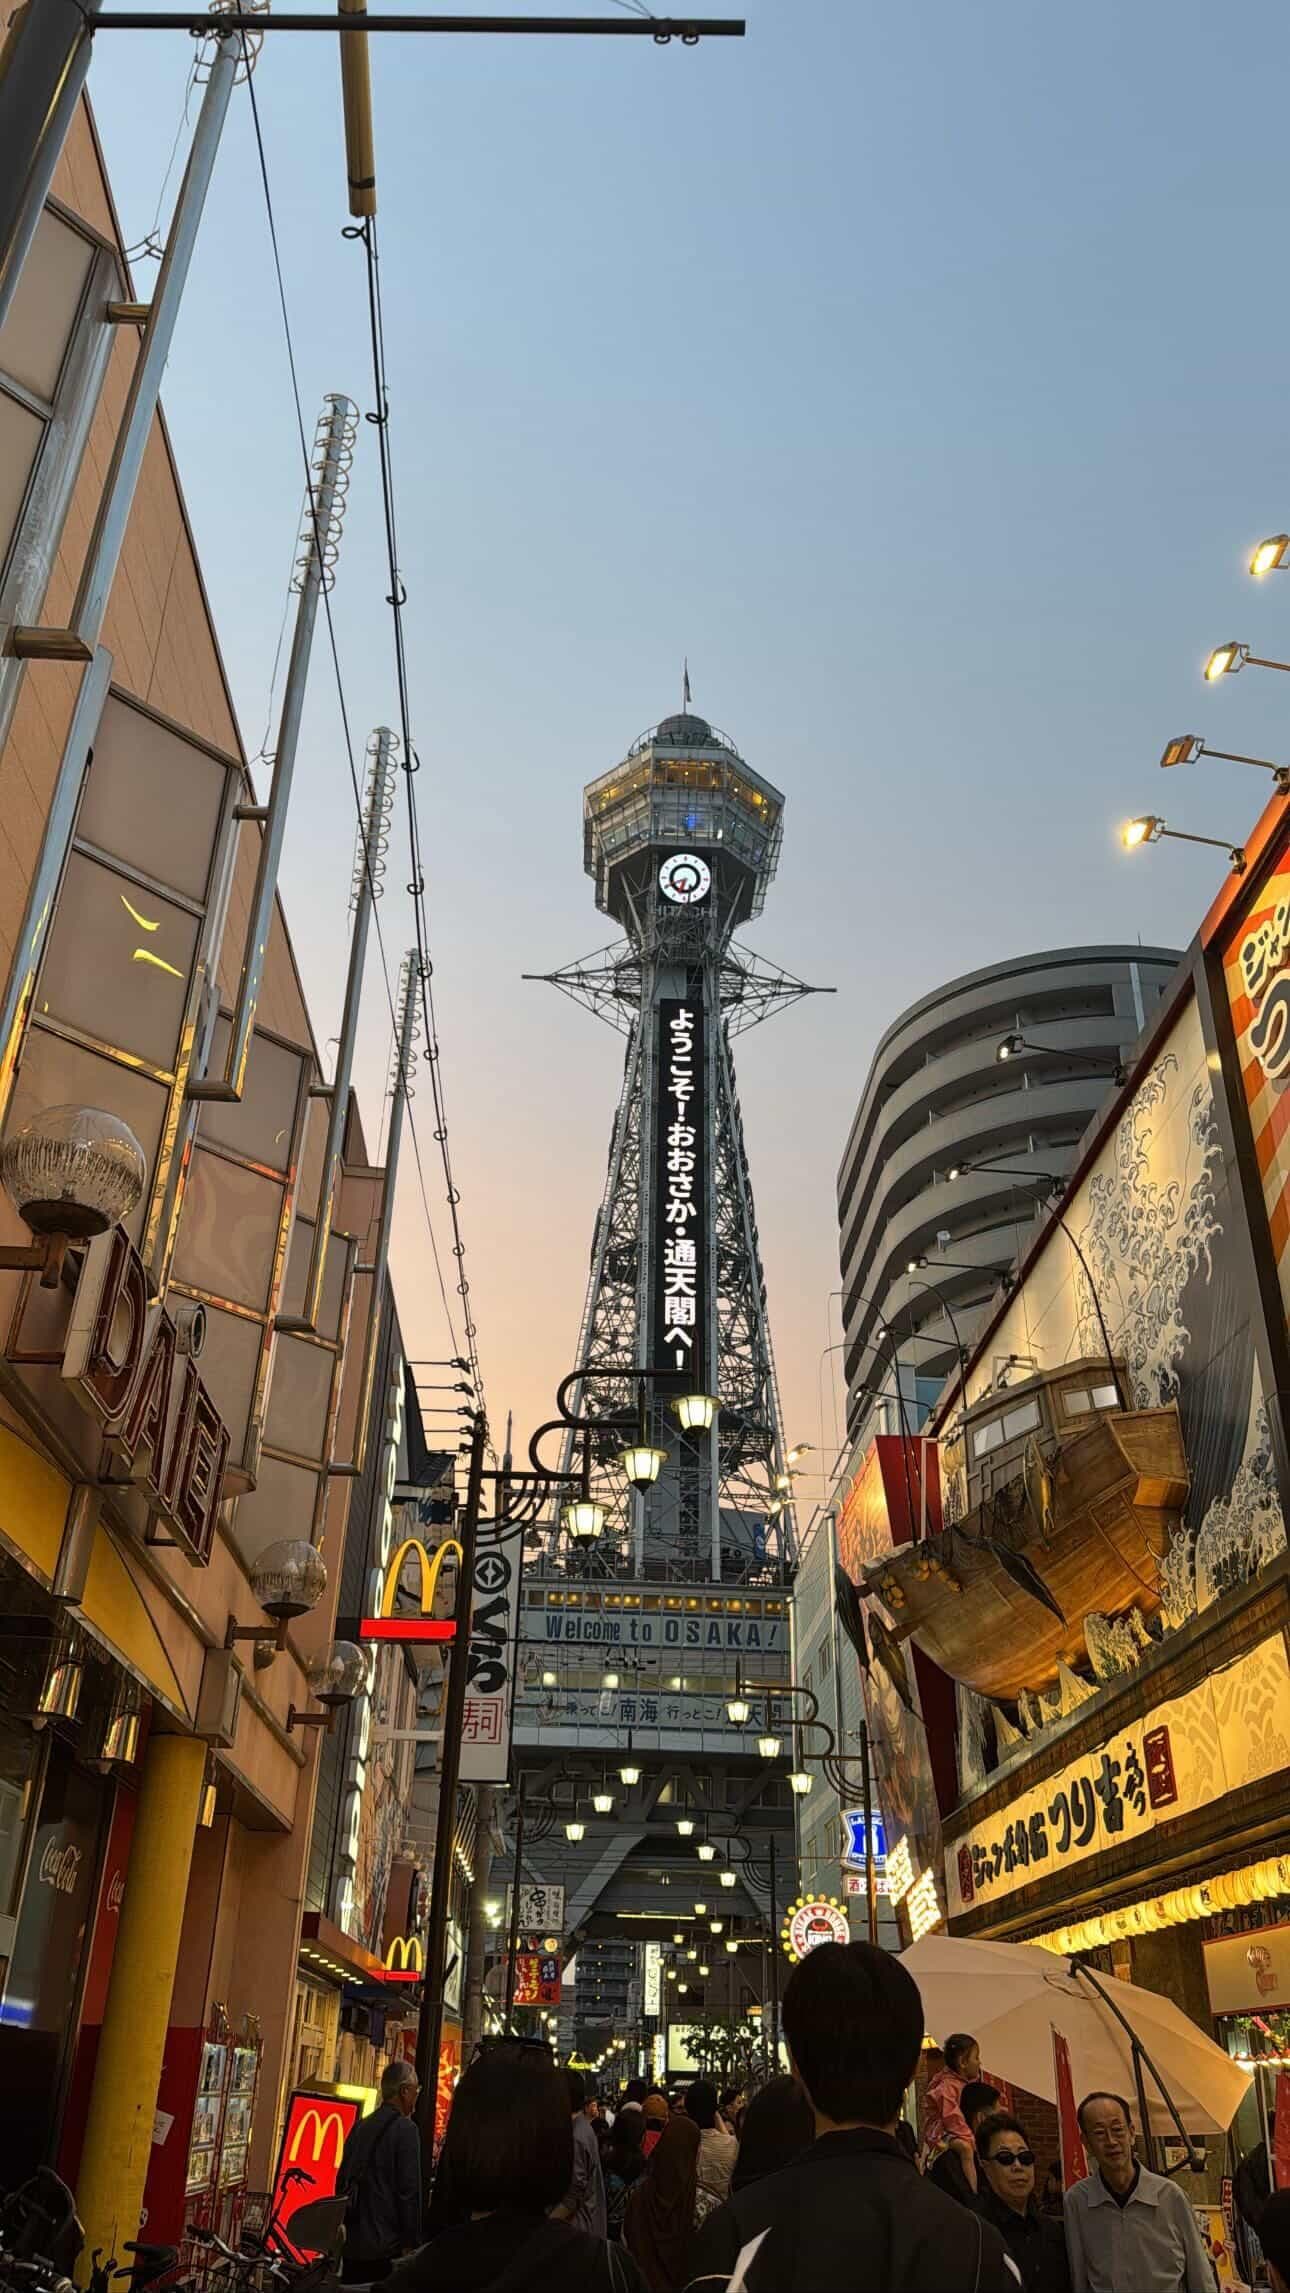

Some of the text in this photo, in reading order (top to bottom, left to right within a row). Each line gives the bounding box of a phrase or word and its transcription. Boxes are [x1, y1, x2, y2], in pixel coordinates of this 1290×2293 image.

[664, 1008, 697, 1371] ようこそ!おおさか・通天閣へ!
[546, 1615, 779, 1648] Welcome to OSAKA!
[620, 1697, 659, 1724] 南海
